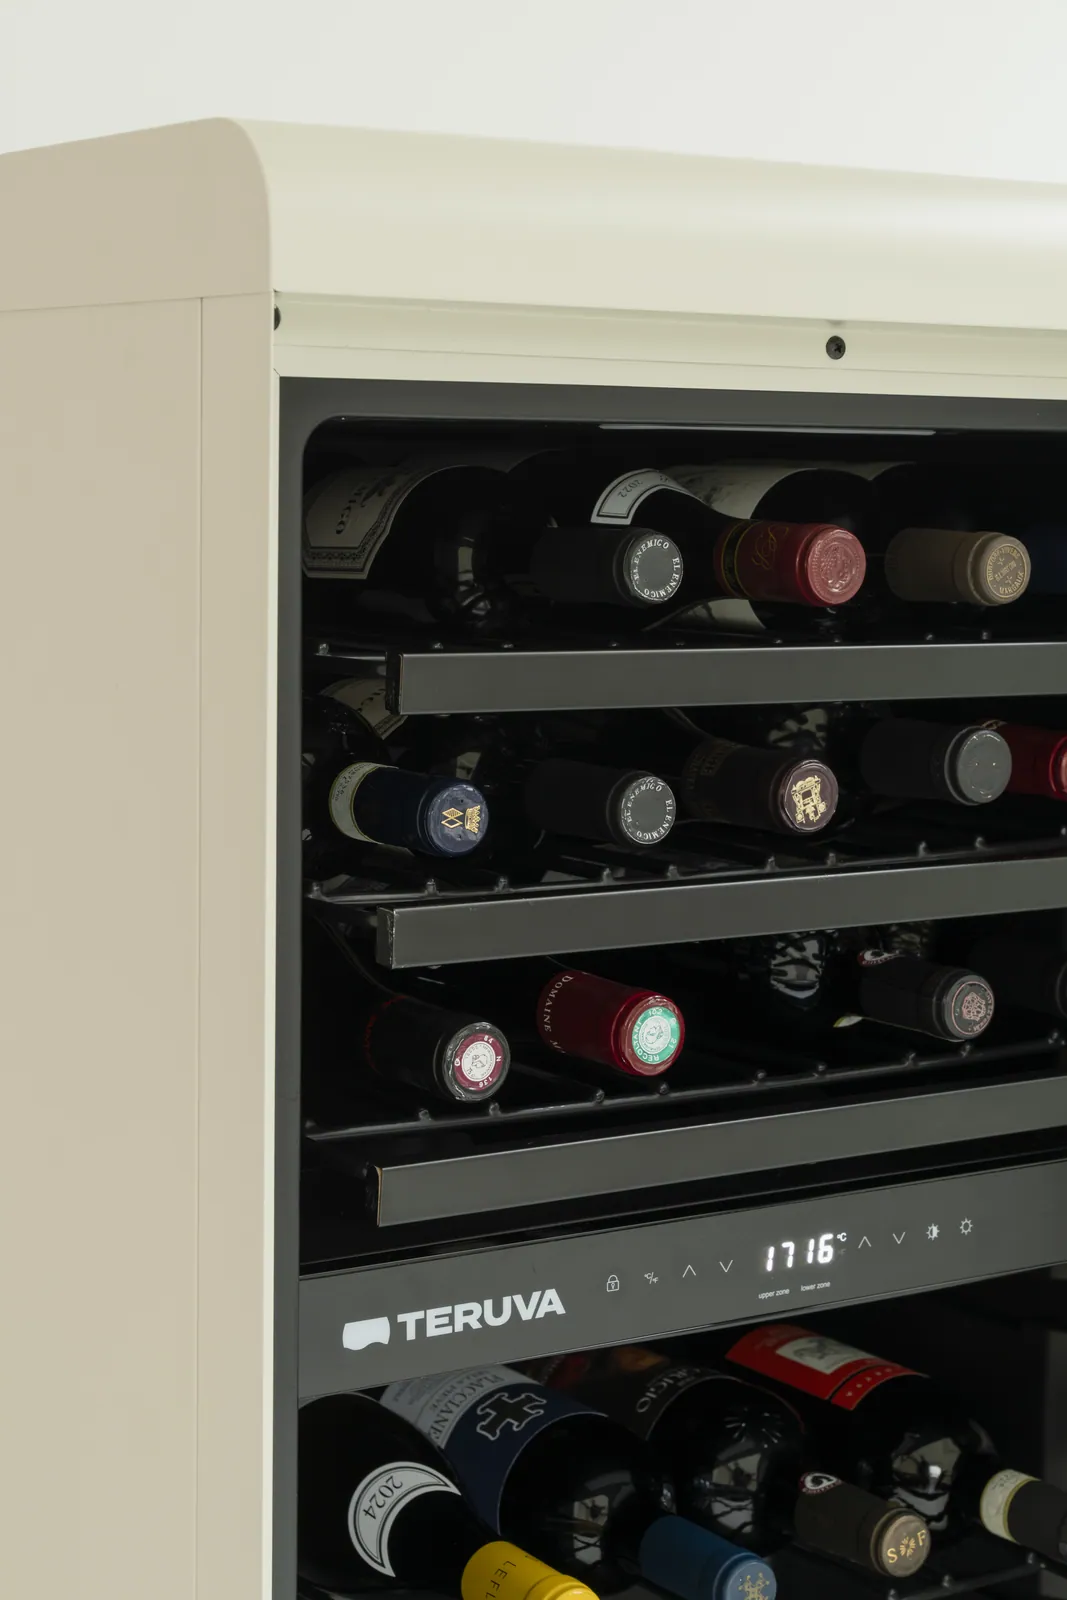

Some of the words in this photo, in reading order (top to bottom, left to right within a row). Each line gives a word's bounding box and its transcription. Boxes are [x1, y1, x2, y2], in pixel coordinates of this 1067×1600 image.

[618, 479, 643, 498] 2022
[672, 557, 681, 571] EL
[999, 571, 1025, 595] MARGAUX
[665, 799, 674, 812] EL
[484, 1035, 494, 1044] 84
[669, 1038, 677, 1049] 21
[479, 1076, 493, 1088] 136
[766, 1246, 795, 1272] 17
[807, 1233, 833, 1264] 16
[836, 1232, 847, 1242] °C
[800, 1283, 816, 1292] lower
[816, 1281, 831, 1289] zone
[758, 1290, 775, 1300] upper
[775, 1288, 790, 1296] zone
[397, 1288, 566, 1341] TERUVA
[363, 1475, 403, 1520] 2024
[886, 1547, 898, 1564] S
[916, 1529, 927, 1546] F
